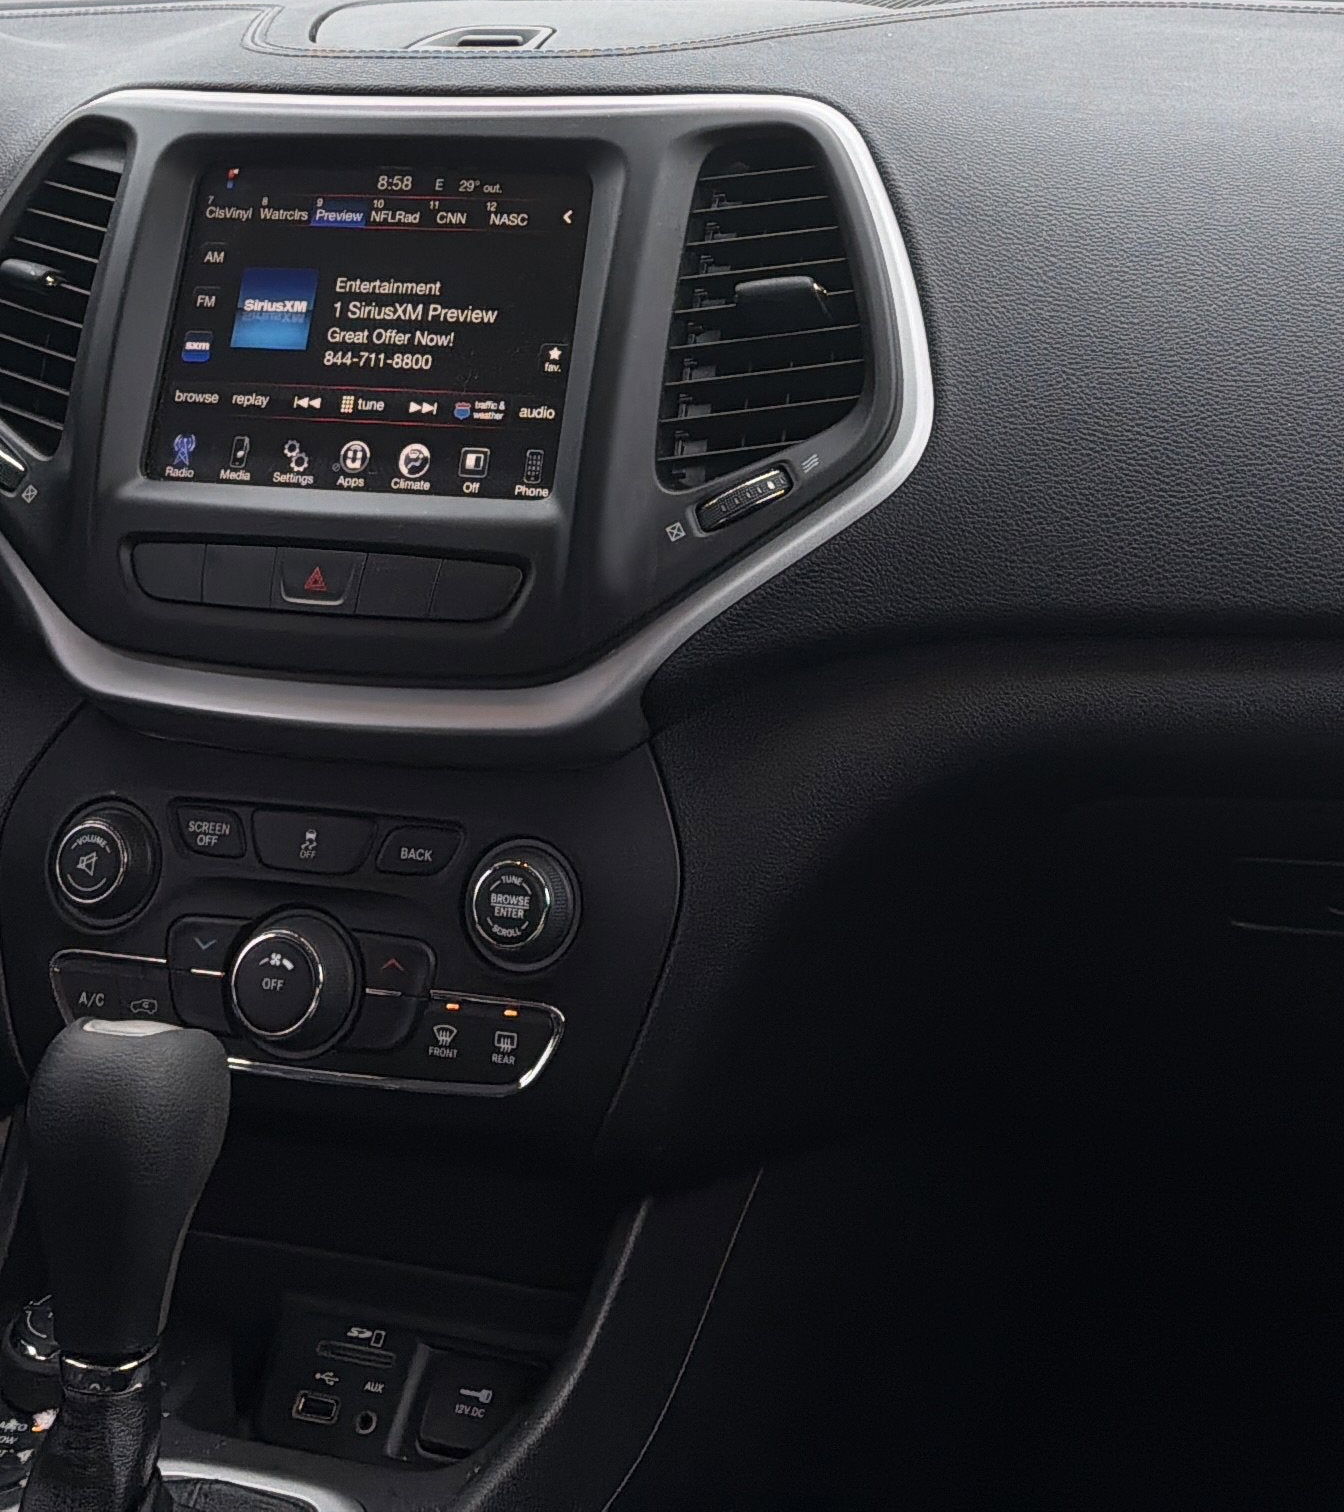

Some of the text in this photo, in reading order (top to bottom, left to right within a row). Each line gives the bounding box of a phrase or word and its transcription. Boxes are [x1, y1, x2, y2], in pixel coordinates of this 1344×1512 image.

[377, 175, 503, 194] 8:58 E 29° out.
[207, 195, 214, 205] 7
[261, 196, 269, 206] 8
[316, 198, 324, 207] 9
[372, 199, 384, 208] 10
[429, 200, 439, 210] 11
[486, 202, 497, 211] 12
[259, 208, 308, 221] Watrclrs
[315, 209, 364, 222] Preview
[370, 210, 420, 224] NFLRad
[436, 212, 467, 224] CNN
[489, 213, 528, 226] NASC
[204, 251, 225, 263] AM
[335, 277, 441, 296] Entertainment
[196, 294, 216, 308] FM
[243, 298, 308, 313] SiriusXM
[333, 301, 498, 324] 1 SiriusXM Preview
[327, 327, 456, 347] Great Offer Now!
[323, 350, 433, 370] 844-711-8800
[544, 361, 562, 373] fav.
[174, 389, 219, 404] browse
[231, 392, 270, 408] replay
[357, 396, 385, 412] tune
[475, 400, 506, 410] traffic &
[472, 411, 505, 421] weather
[519, 405, 556, 420] audio
[164, 464, 195, 478] Radio
[219, 468, 251, 481] Media
[272, 471, 314, 486] Settings
[336, 475, 365, 488] Apps
[391, 477, 431, 491] Climate
[462, 481, 481, 494] Off
[514, 484, 550, 498] Phone
[188, 820, 231, 835] SCREEN
[76, 834, 108, 848] VOLUME
[196, 834, 219, 847] OFF
[299, 849, 317, 859] OFF
[400, 847, 433, 862] BACK
[500, 875, 524, 886] TUNE
[490, 893, 530, 907] BROWSE
[493, 906, 524, 920] ENTER
[491, 924, 522, 938] SCROLL
[261, 977, 284, 992] OFF
[78, 991, 105, 1008] A/C
[428, 1046, 458, 1059] FRONT
[491, 1053, 516, 1065] REAR
[364, 1381, 385, 1394] AUX
